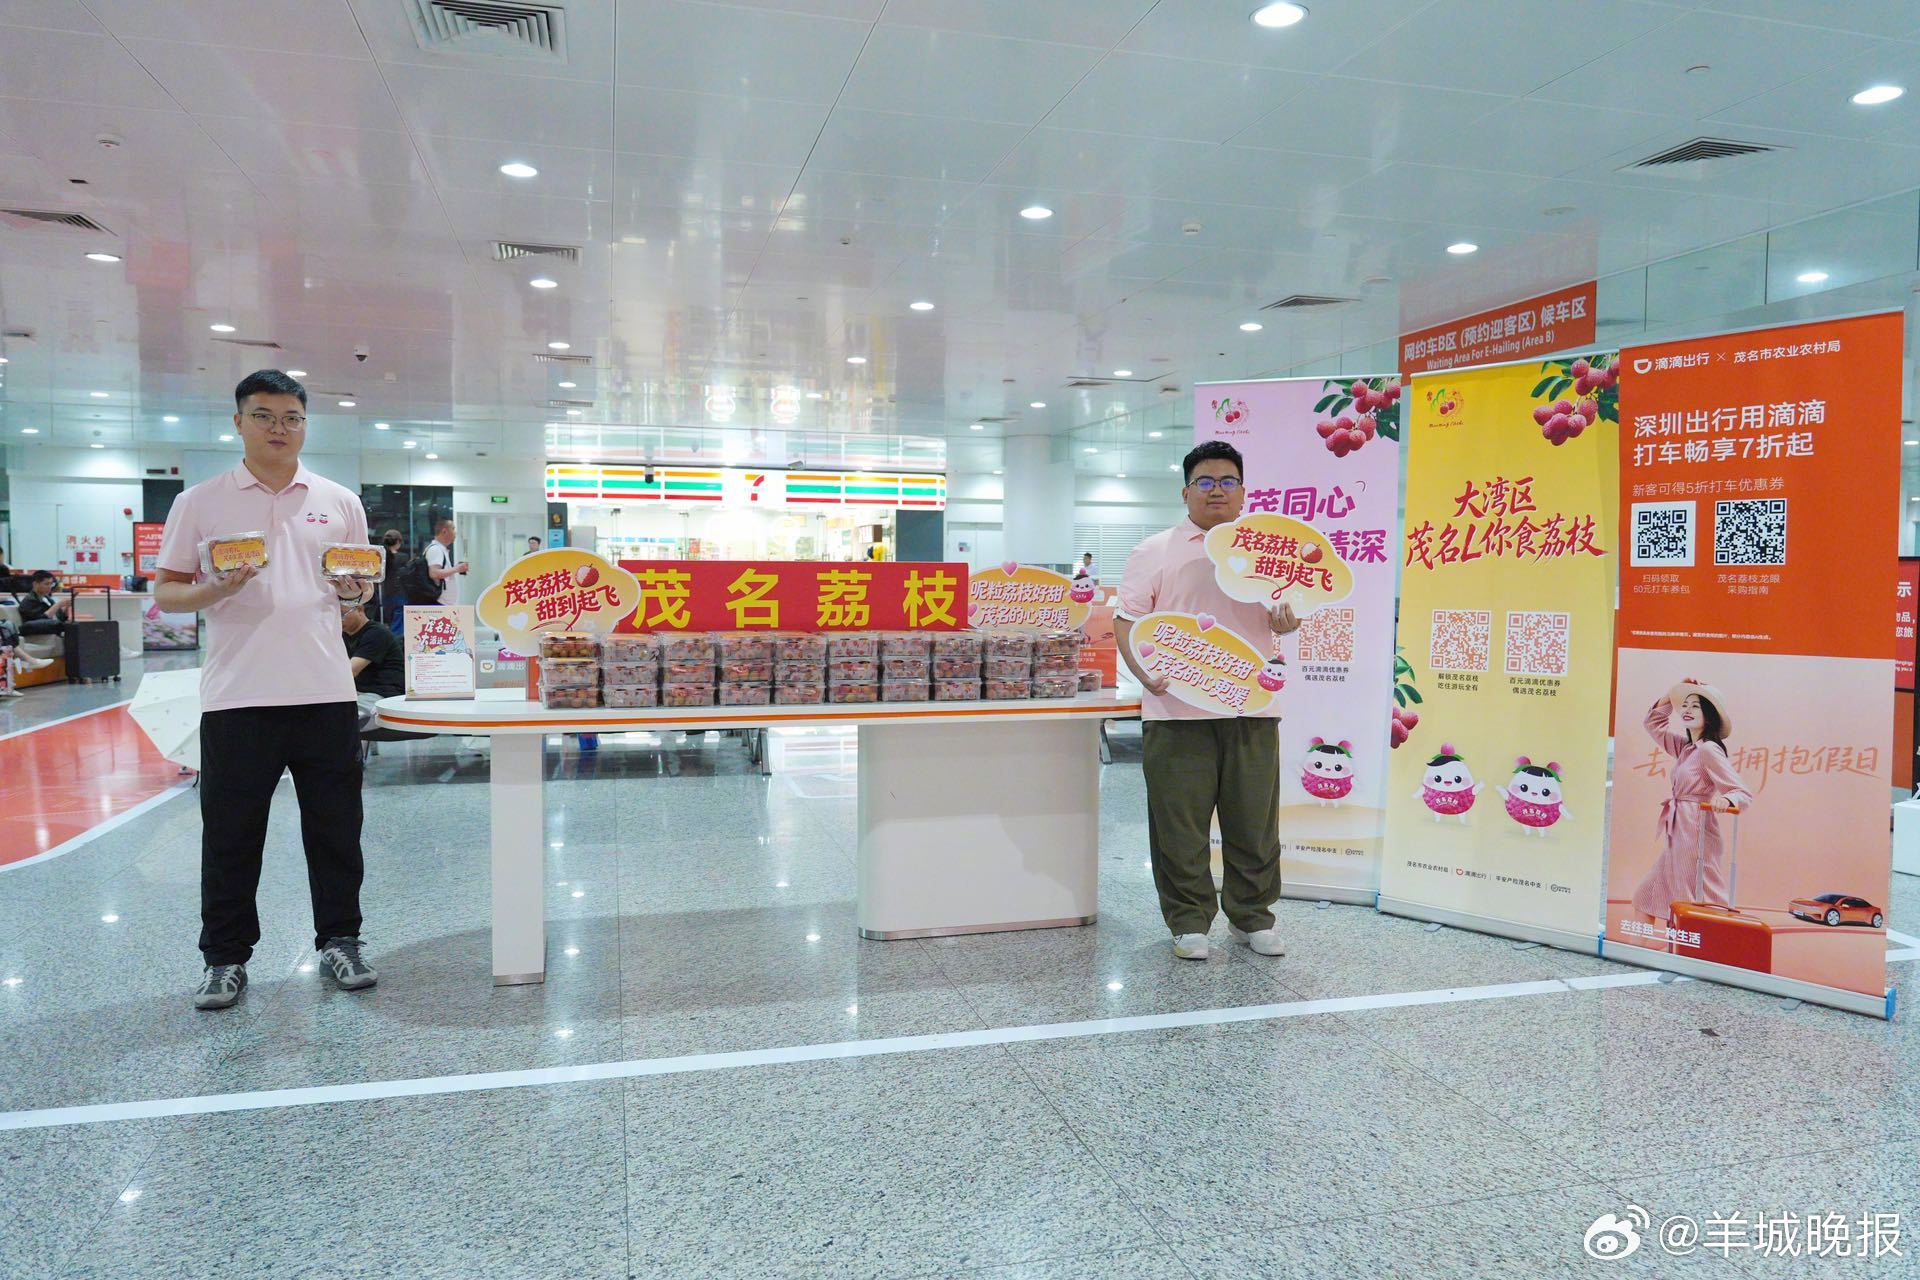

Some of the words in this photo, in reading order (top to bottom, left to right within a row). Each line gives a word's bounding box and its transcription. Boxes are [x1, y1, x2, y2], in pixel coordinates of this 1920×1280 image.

[1404, 331, 1457, 363] 网约车B区
[1541, 296, 1587, 328] 候车区
[1426, 353, 1453, 371] Waiting
[1454, 349, 1470, 364] Area
[1471, 348, 1485, 361] For
[1485, 340, 1521, 357] E-Hailing
[1522, 335, 1545, 351] (Area
[1545, 331, 1555, 344] B)
[1654, 352, 1710, 371] 滴滴出行
[1733, 340, 1841, 364] 茂名市农业农村局
[1634, 399, 1826, 439] 深圳出行用滴滴
[1633, 431, 1815, 467] 打车畅享7折起
[1453, 476, 1537, 519] 大湾区
[1632, 476, 1785, 497] 新客可得5折打车优惠券
[1230, 526, 1298, 559] 茂名荔枝
[504, 569, 575, 608] 茂名荔枝
[970, 580, 1065, 604] 呢粒荔枝好甜
[1255, 555, 1333, 593] 甜到起飞
[1642, 573, 1680, 583] 扫码领取
[1717, 573, 1781, 584] 茂名荔枝龙眼
[1727, 585, 1769, 595] 采购指南
[535, 584, 621, 622] 甜到起飞
[631, 568, 957, 629] 茂名荔枝
[978, 605, 1071, 632] 茂名的心更暖
[1152, 620, 1257, 682] 呢粒荔枝好甜
[1148, 652, 1251, 714] 茂名的心更暖
[1437, 682, 1478, 691] 吃住游玩全有
[1633, 746, 1667, 778] 去
[1732, 746, 1882, 793] 拥抱假日
[1620, 919, 1701, 944] 去往每一种生活
